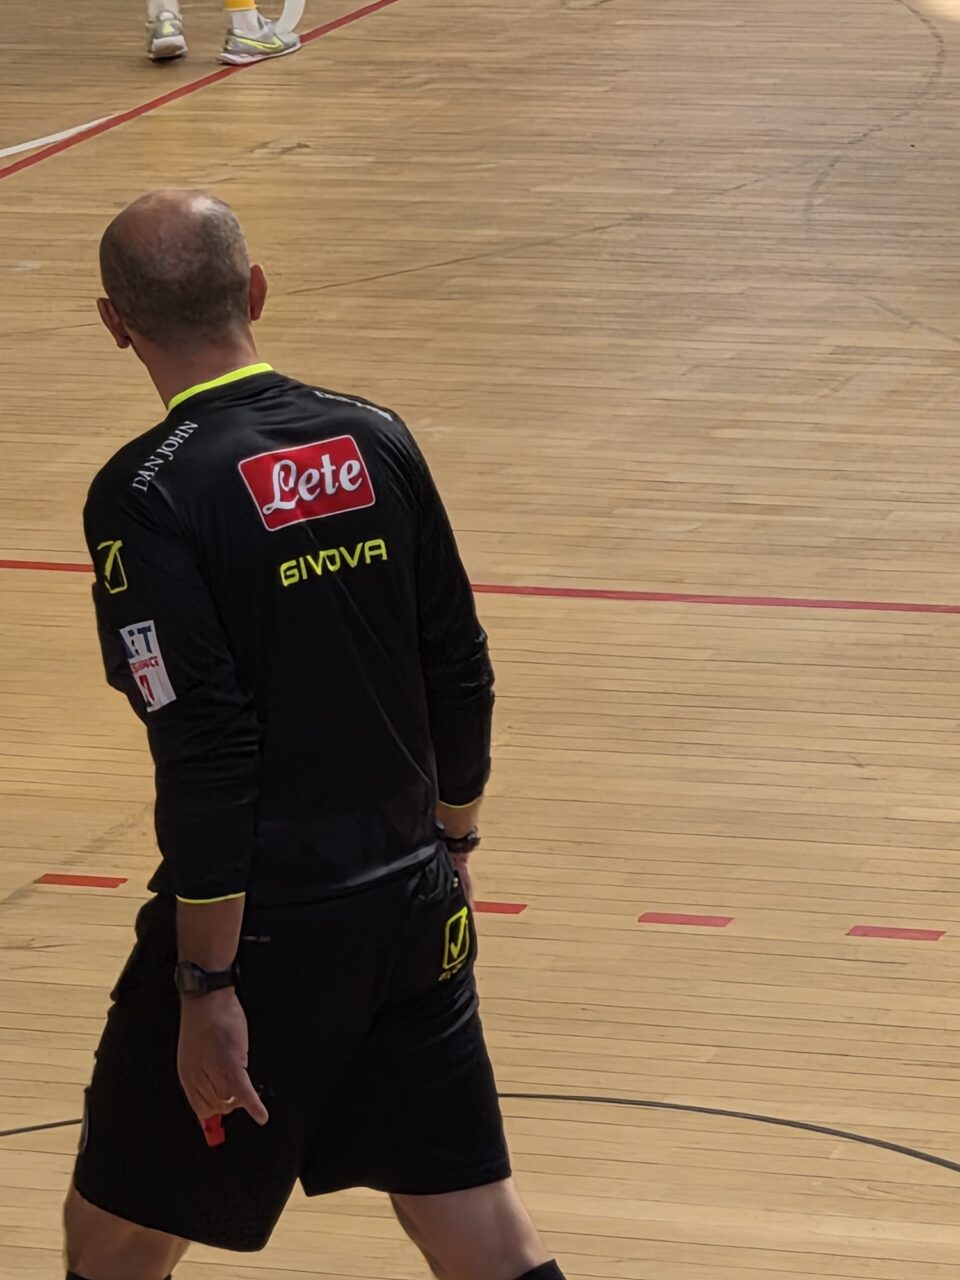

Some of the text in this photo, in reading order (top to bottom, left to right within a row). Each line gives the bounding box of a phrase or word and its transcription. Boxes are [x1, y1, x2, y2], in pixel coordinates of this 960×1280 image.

[132, 421, 199, 493] DAN JOHN
[262, 453, 363, 515] Lete
[279, 538, 388, 587] GIVOVA
